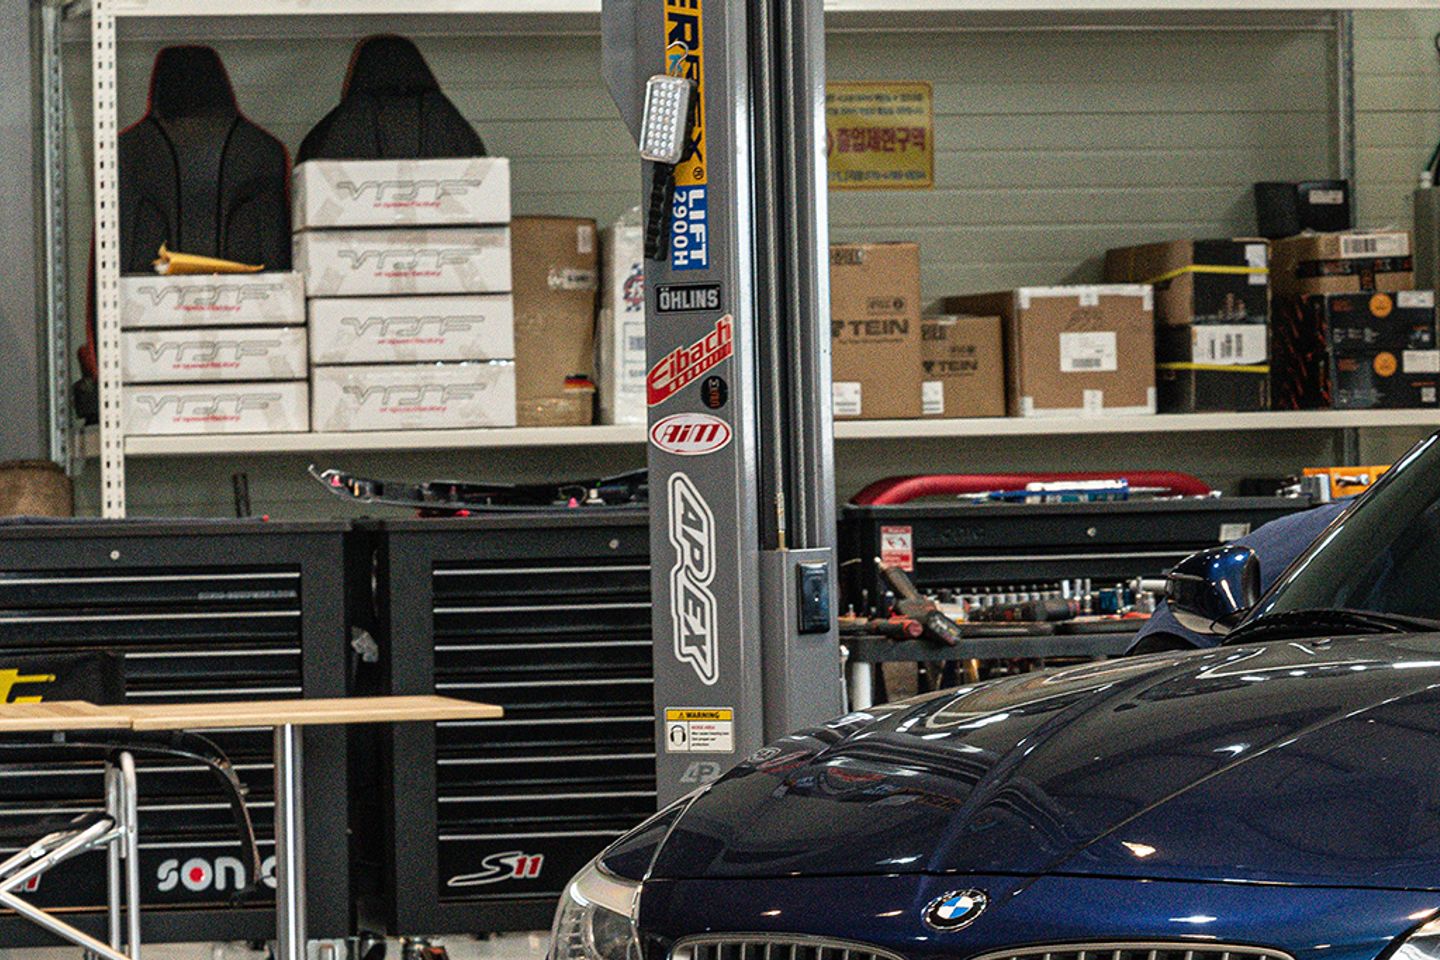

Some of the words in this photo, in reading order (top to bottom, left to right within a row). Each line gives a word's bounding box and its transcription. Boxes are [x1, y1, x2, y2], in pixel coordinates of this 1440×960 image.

[673, 191, 689, 266] 2900H
[688, 188, 706, 266] LIFT
[659, 286, 719, 310] ÖHLINS
[848, 319, 909, 335] TEIN
[648, 318, 732, 391] Eibach
[938, 360, 978, 371] TEIN
[672, 477, 716, 683] APEX
[685, 711, 721, 719] WARNING
